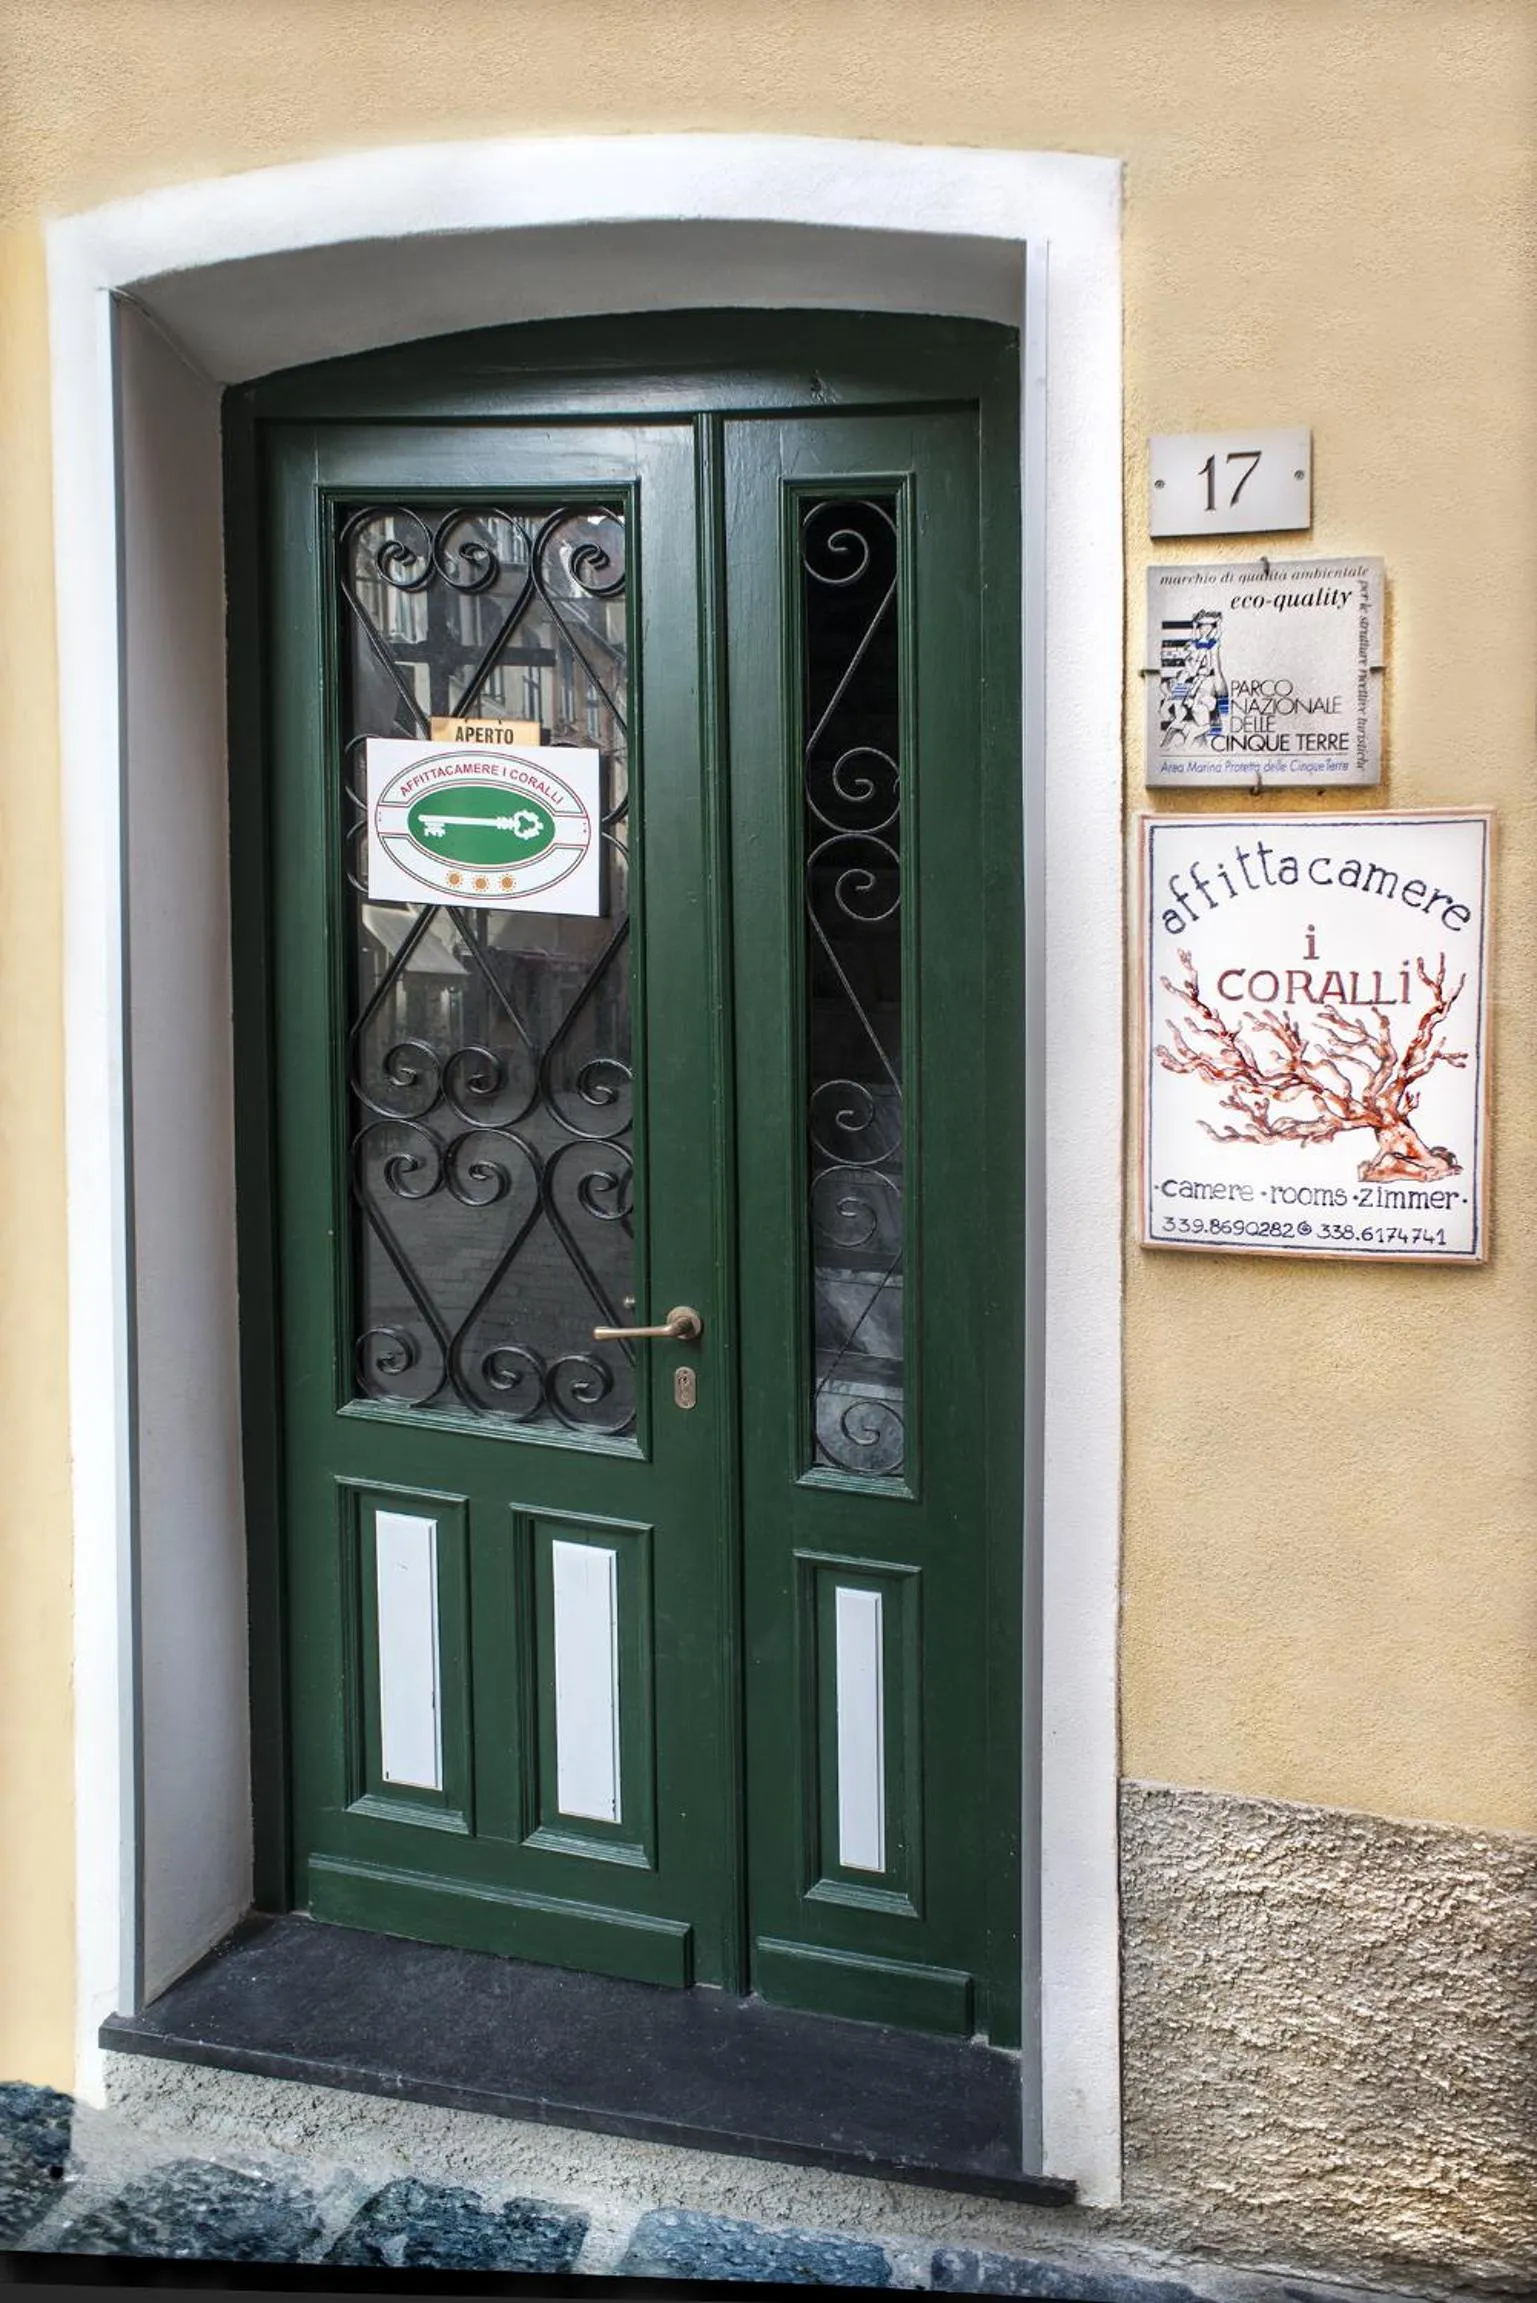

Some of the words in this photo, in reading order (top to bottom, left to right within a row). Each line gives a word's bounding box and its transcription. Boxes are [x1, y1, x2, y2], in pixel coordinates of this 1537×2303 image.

[1198, 450, 1263, 512] 17
[1160, 573, 1217, 586] marchio
[1220, 571, 1234, 583] di
[1291, 566, 1370, 581] ambientale
[1230, 587, 1353, 612] eco-quality
[1357, 580, 1371, 602] per
[1359, 603, 1372, 614] le
[1230, 679, 1294, 698] PARCO
[1230, 696, 1342, 716] NAZIONALE
[1230, 715, 1277, 733] DELLE
[455, 726, 514, 745] APERTO
[1211, 733, 1291, 752] CINQUE
[1295, 733, 1349, 751] TERRE
[1160, 761, 1184, 774] Area
[1186, 761, 1222, 774] Marina
[1225, 760, 1260, 773] Protetta
[1263, 760, 1288, 773] delle
[399, 763, 498, 797] AFFITTACAMERE
[502, 768, 507, 777] I
[509, 769, 563, 805] CORALLI
[1161, 841, 1472, 935] affittacamere
[1303, 924, 1320, 960] i
[1316, 1225, 1447, 1246] 338.6174741
